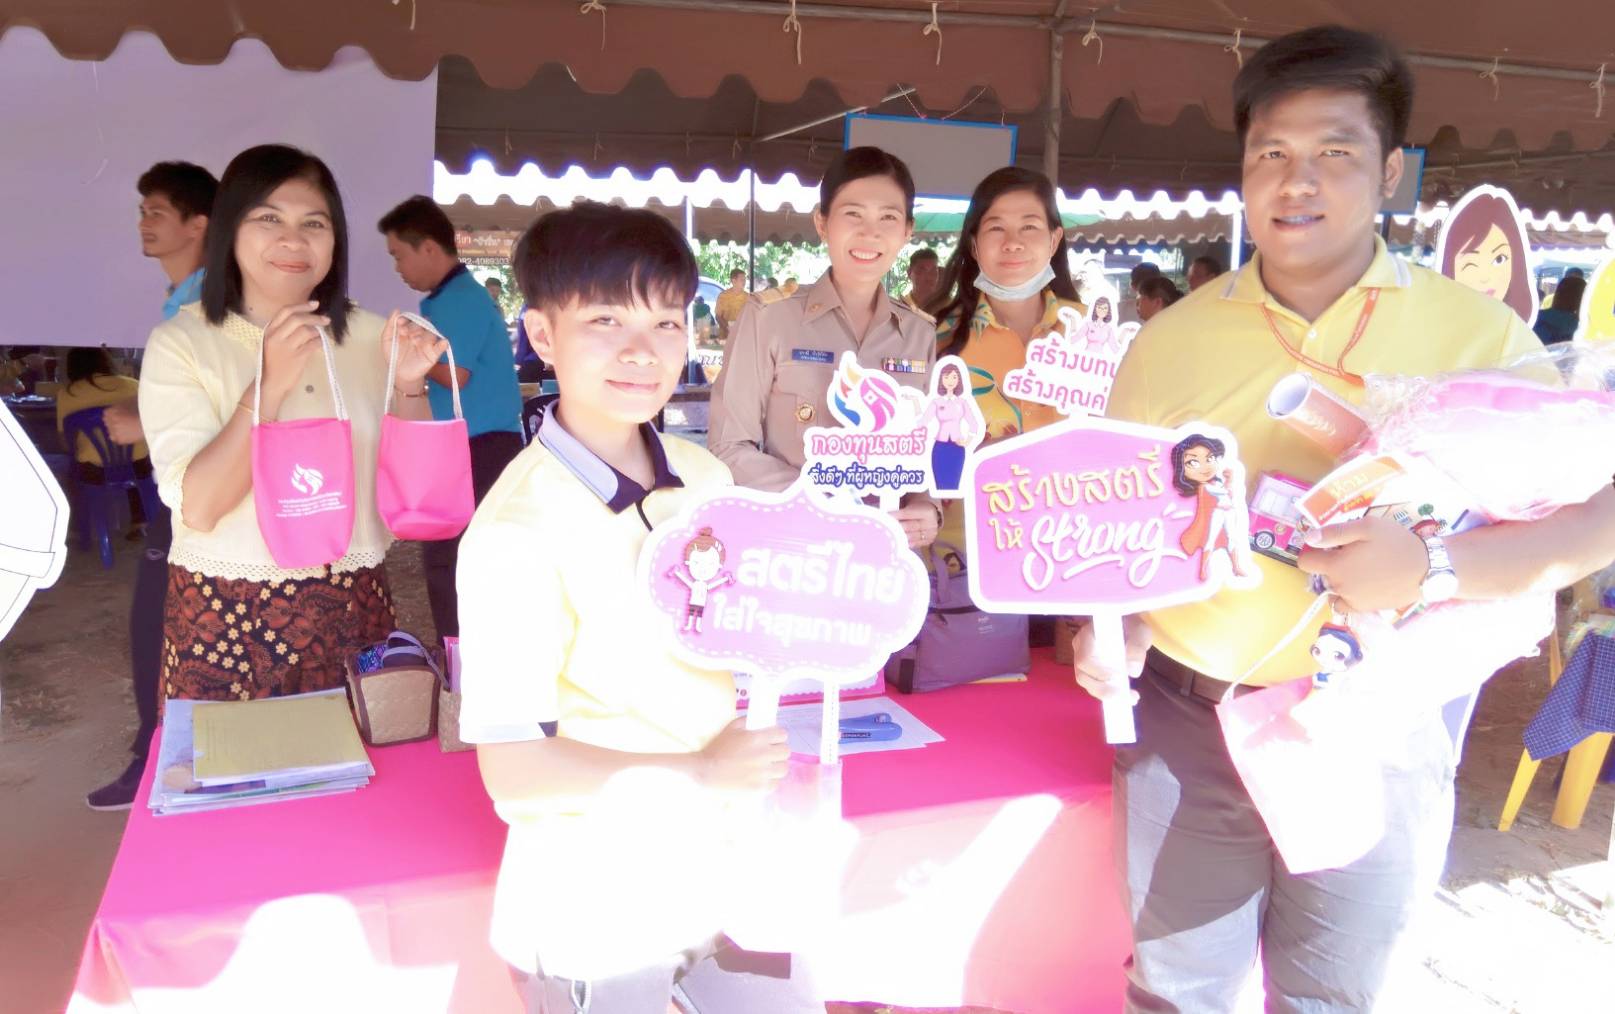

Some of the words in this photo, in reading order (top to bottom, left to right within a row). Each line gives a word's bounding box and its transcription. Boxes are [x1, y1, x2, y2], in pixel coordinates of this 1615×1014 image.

[811, 426, 928, 465] กองทุนสตรี
[982, 444, 1165, 514] สร้างสตรี
[736, 538, 908, 604] สตรีไทย
[988, 517, 1024, 550] ให้
[1022, 511, 1187, 592] Strong
